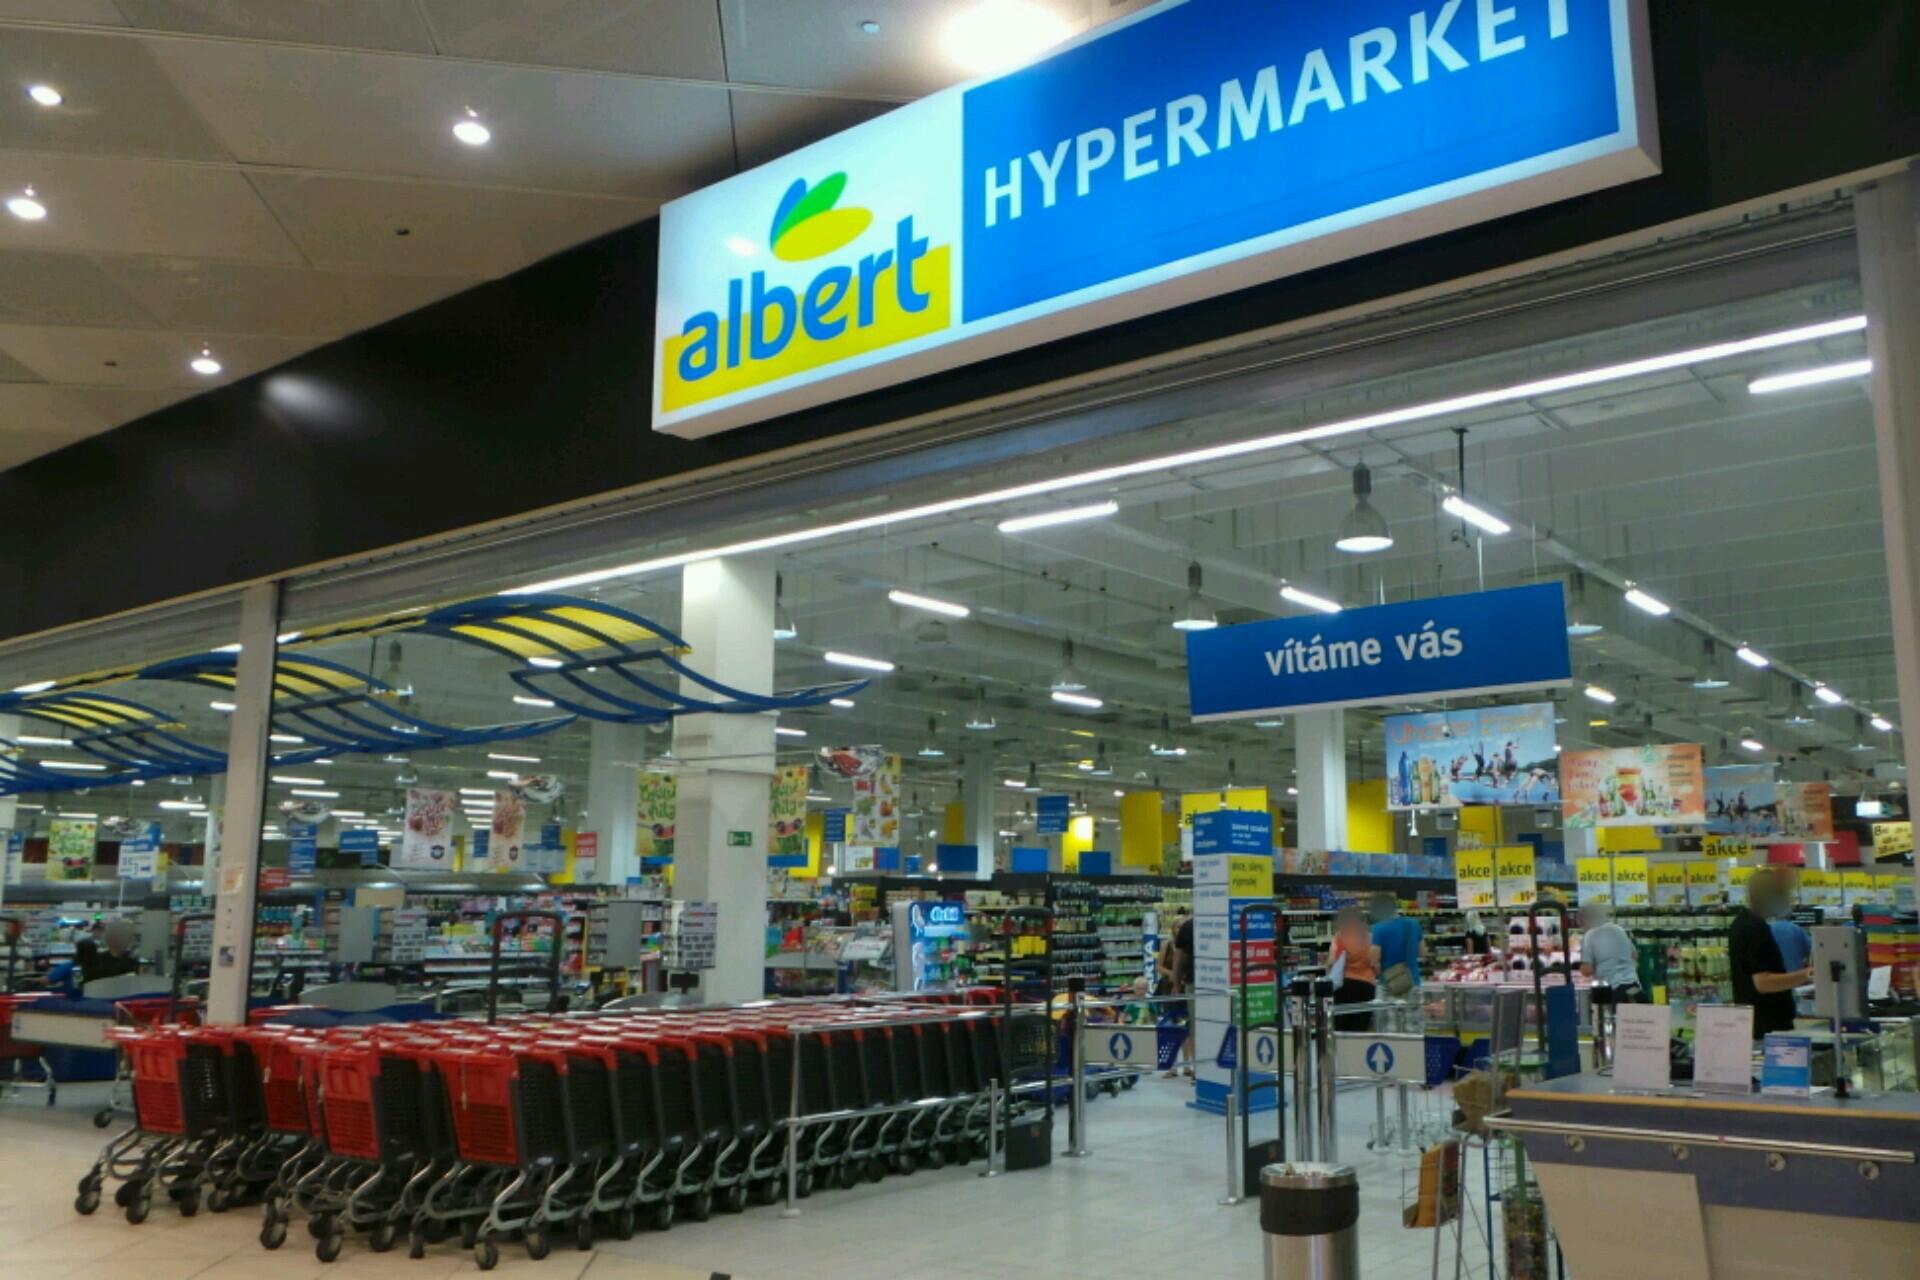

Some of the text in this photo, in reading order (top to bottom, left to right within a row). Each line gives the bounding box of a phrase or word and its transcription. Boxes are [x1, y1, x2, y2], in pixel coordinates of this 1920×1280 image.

[678, 214, 930, 382] albert
[1265, 619, 1464, 676] vítáme vás
[1705, 838, 1748, 856] akce
[1459, 864, 1490, 878] akce
[1499, 861, 1532, 876] akce
[1616, 869, 1646, 881] akce
[1579, 871, 1608, 882] akce
[1656, 873, 1683, 883] akce
[1690, 872, 1716, 883] akce
